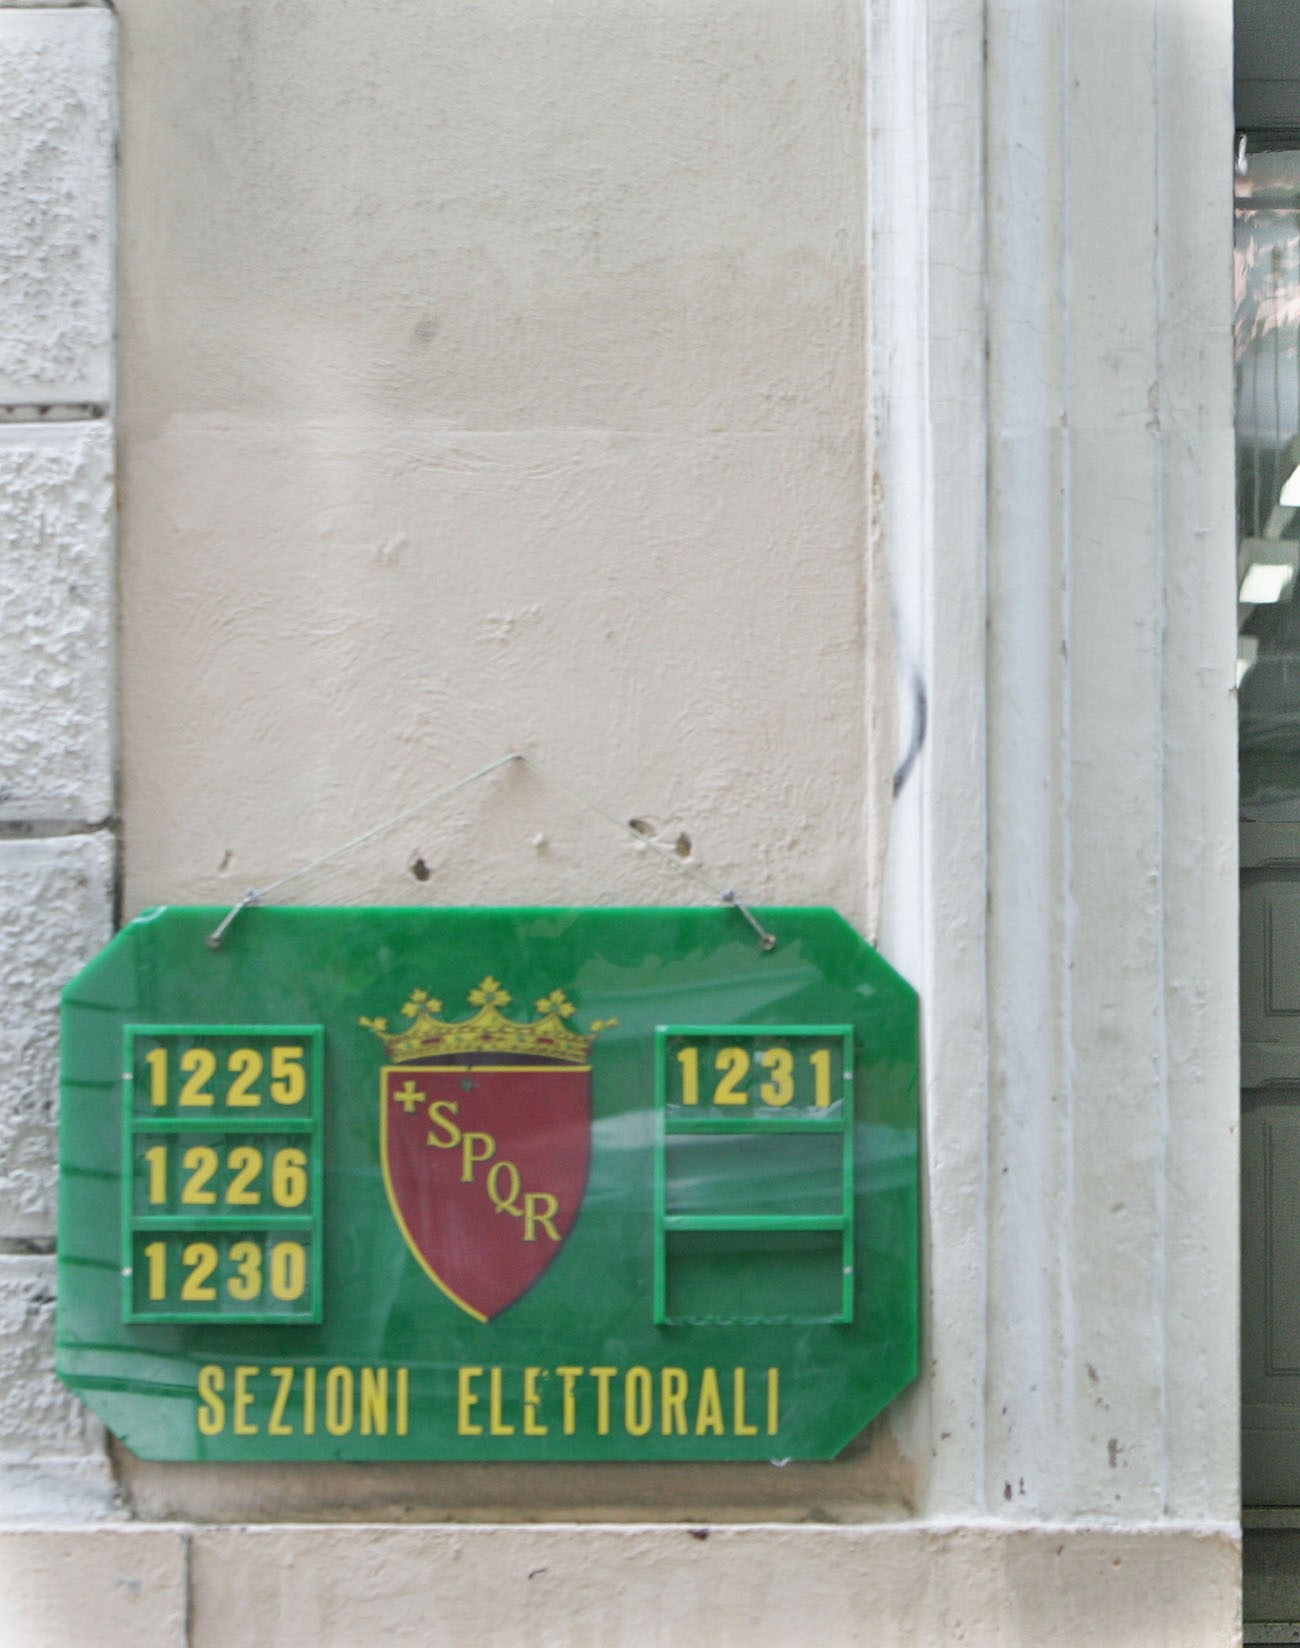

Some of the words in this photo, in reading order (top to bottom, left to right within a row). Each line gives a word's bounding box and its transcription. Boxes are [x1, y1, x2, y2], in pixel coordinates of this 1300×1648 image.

[146, 1046, 306, 1107] 1225
[678, 1047, 831, 1108] 1231
[146, 1147, 307, 1208] 1226
[427, 1101, 561, 1241] SPQR
[145, 1241, 306, 1301] 1230
[198, 1365, 409, 1437] SEZIONI
[458, 1366, 780, 1437] ELETTORALI
